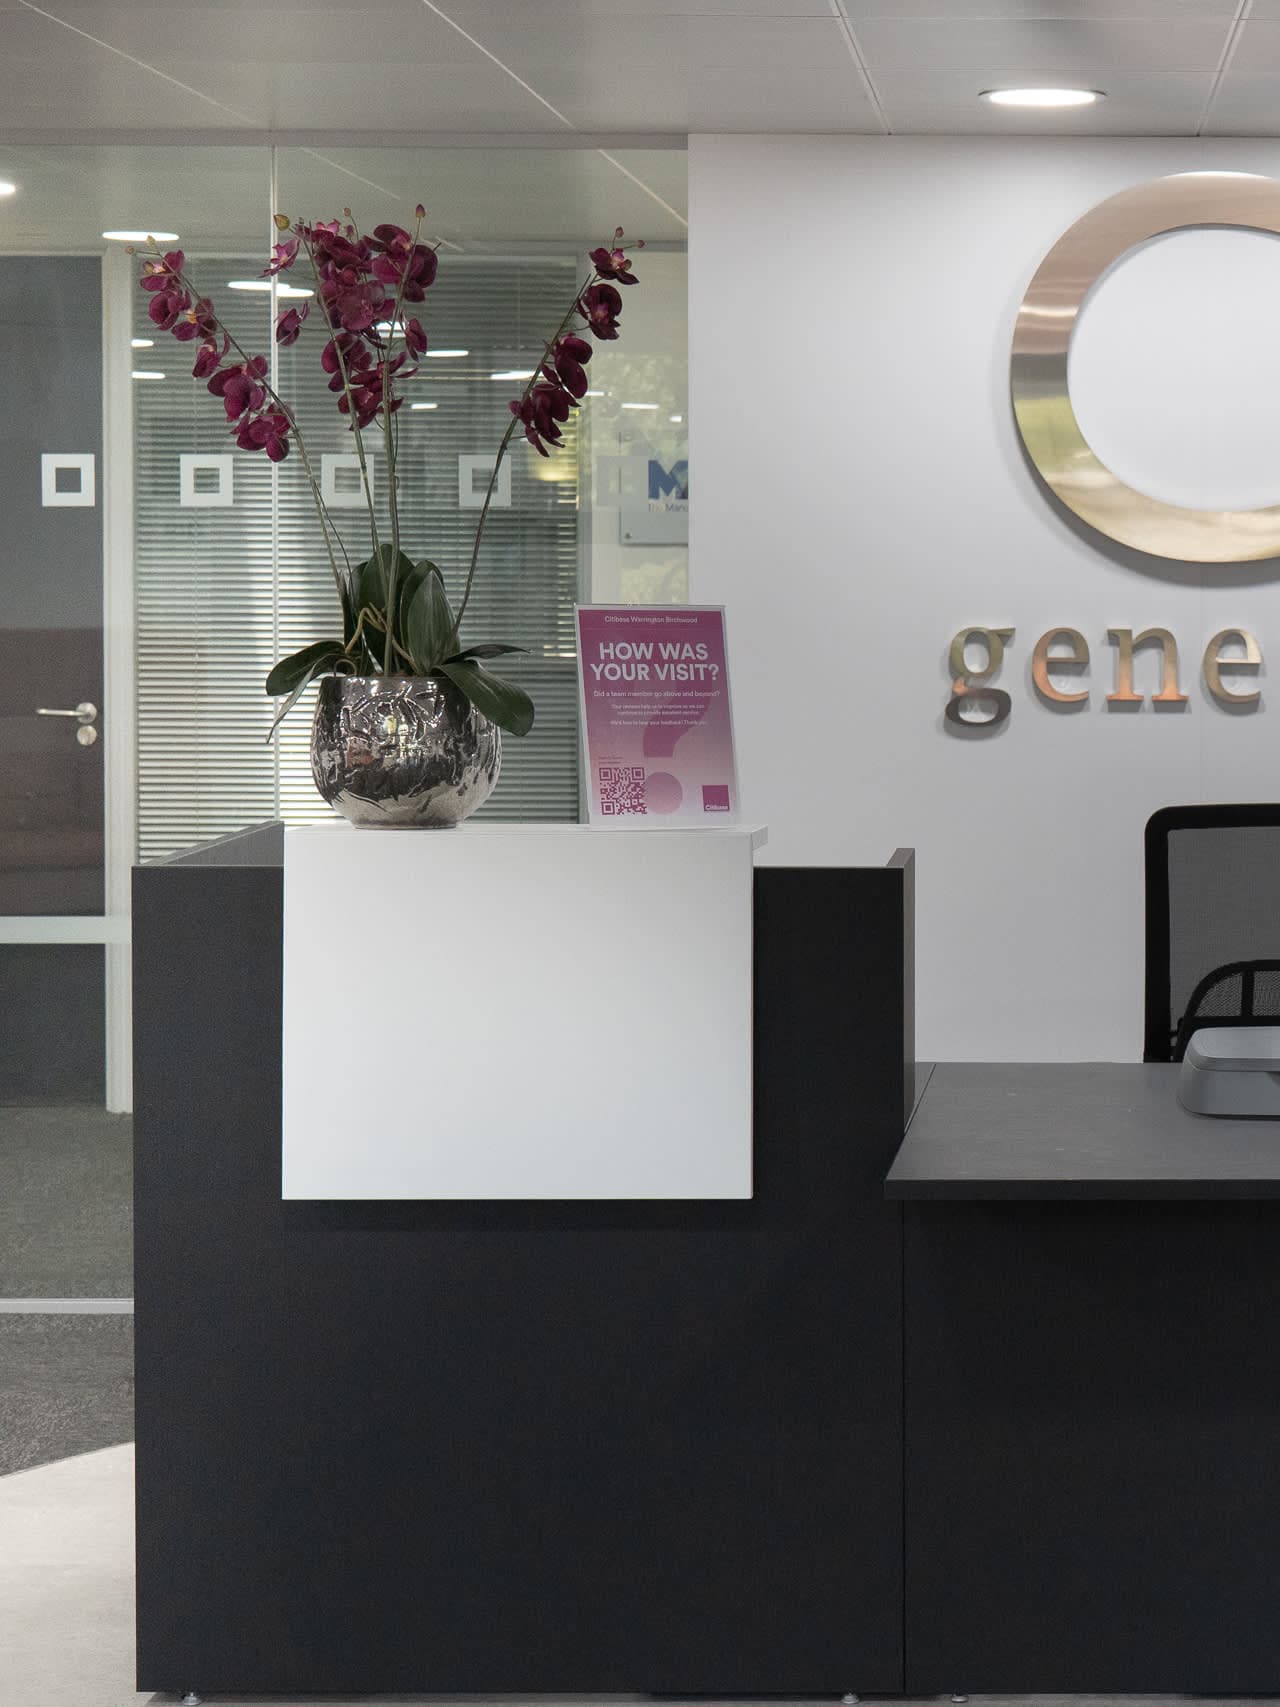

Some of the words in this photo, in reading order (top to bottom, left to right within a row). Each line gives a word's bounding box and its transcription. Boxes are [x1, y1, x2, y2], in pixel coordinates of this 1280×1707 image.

[599, 642, 654, 660] HOW
[658, 643, 709, 661] WAS
[590, 663, 650, 681] YOUR
[653, 663, 719, 681] VISIT?
